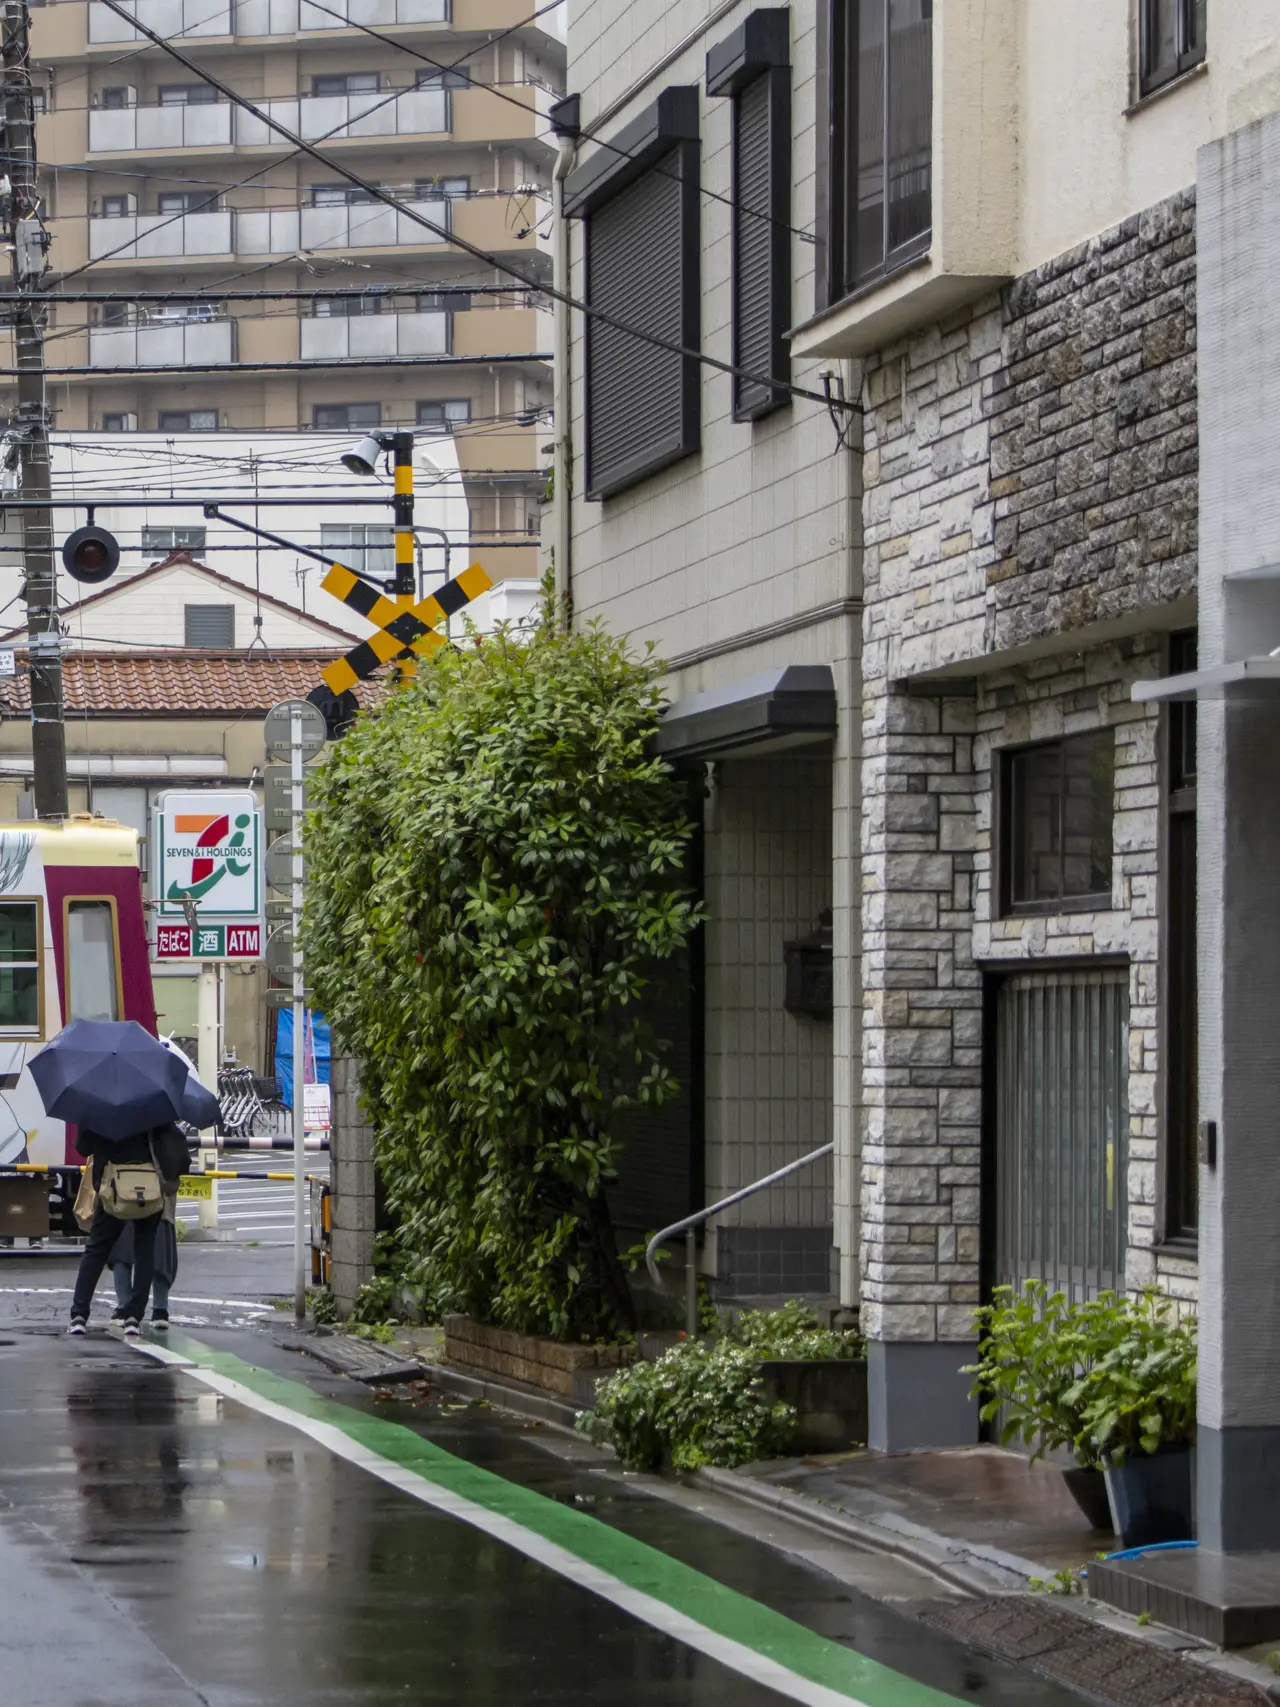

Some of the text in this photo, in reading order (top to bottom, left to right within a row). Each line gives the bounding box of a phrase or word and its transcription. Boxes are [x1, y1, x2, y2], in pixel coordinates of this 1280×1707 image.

[206, 847, 252, 858] HOLDINGS
[158, 930, 190, 952] たばこ
[198, 930, 219, 953] 酒
[228, 930, 258, 952] ATM
